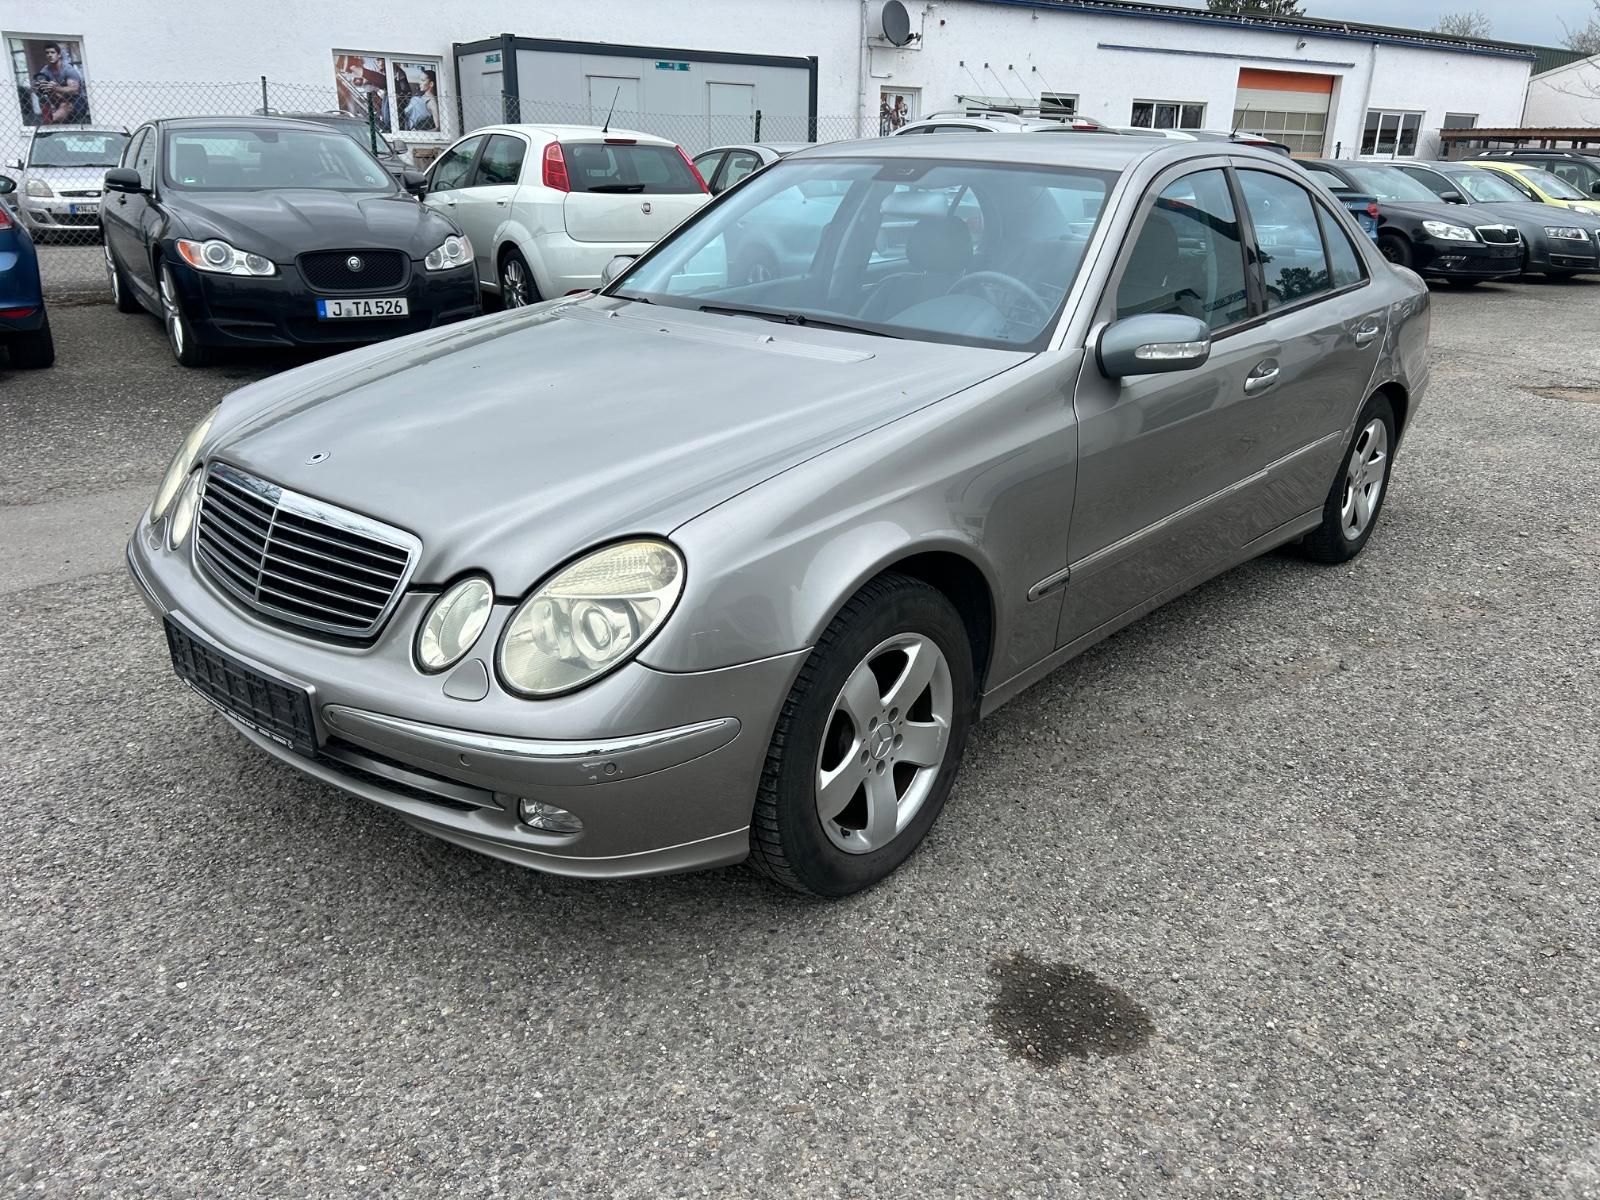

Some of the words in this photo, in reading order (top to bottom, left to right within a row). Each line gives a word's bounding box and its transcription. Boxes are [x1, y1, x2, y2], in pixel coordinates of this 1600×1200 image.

[333, 302, 342, 316] J
[352, 301, 372, 316] TA
[375, 300, 403, 315] 526
